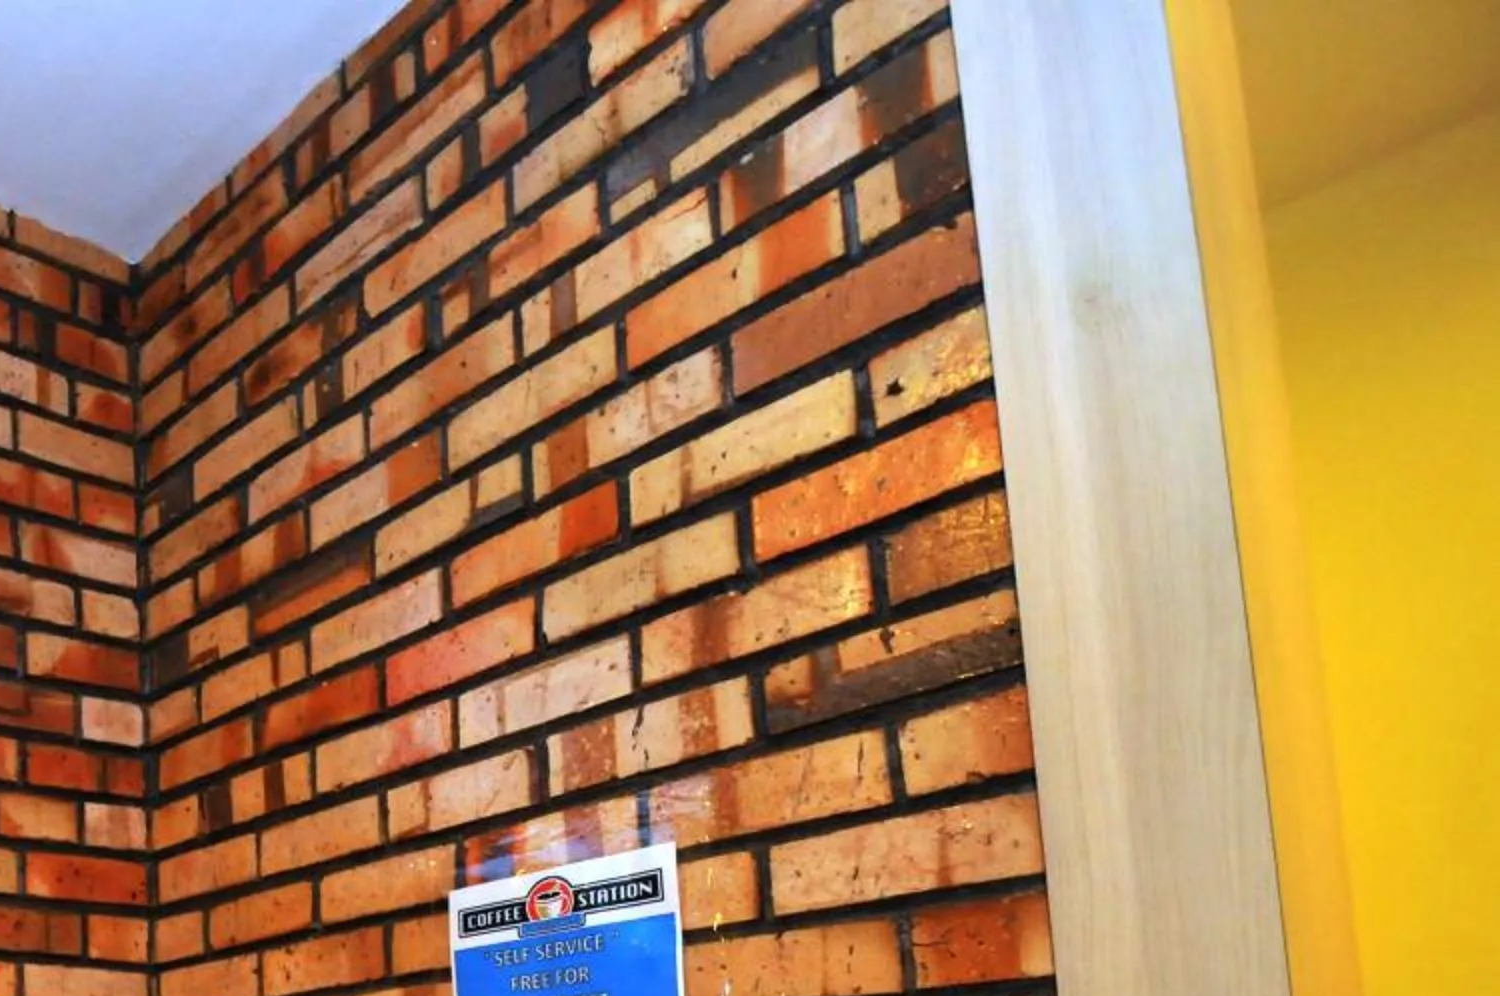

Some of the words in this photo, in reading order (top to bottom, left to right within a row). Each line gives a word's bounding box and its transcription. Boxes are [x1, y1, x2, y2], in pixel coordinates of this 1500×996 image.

[466, 905, 523, 931] COFFEE
[577, 879, 654, 908] STATION
[510, 972, 550, 992] FREE
[555, 966, 590, 986] FOR
